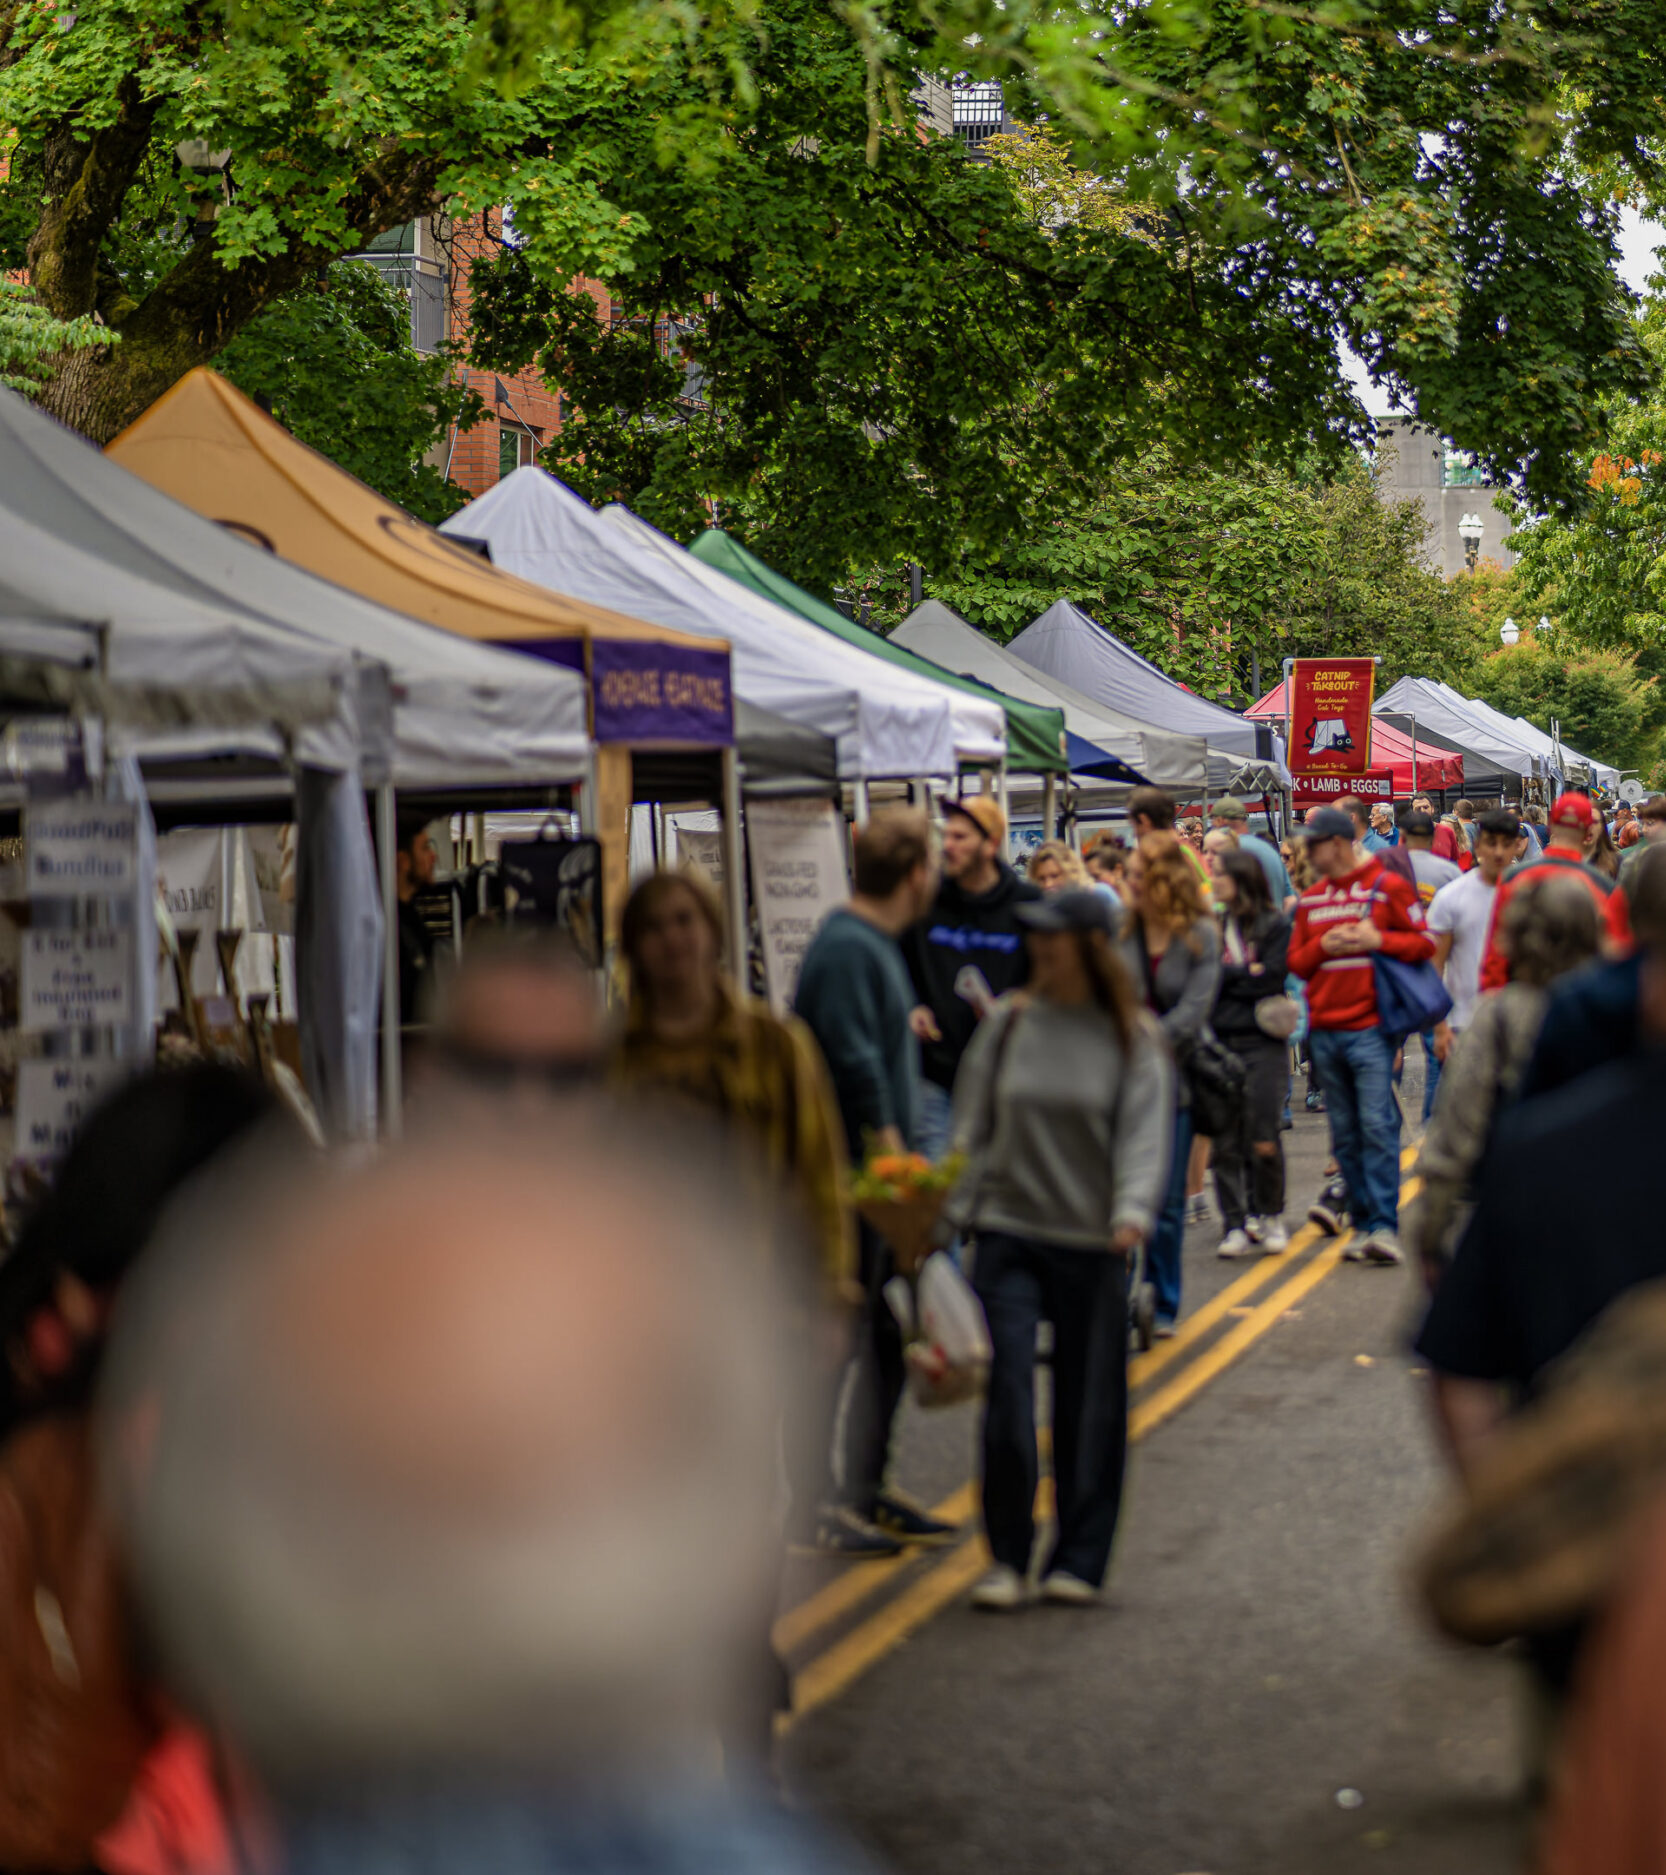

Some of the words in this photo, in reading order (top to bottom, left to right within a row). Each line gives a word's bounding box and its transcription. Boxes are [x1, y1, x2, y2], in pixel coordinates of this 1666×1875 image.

[1315, 671, 1351, 681] CATNIP
[1311, 777, 1340, 792] LAMB
[1350, 779, 1379, 793] EGGS
